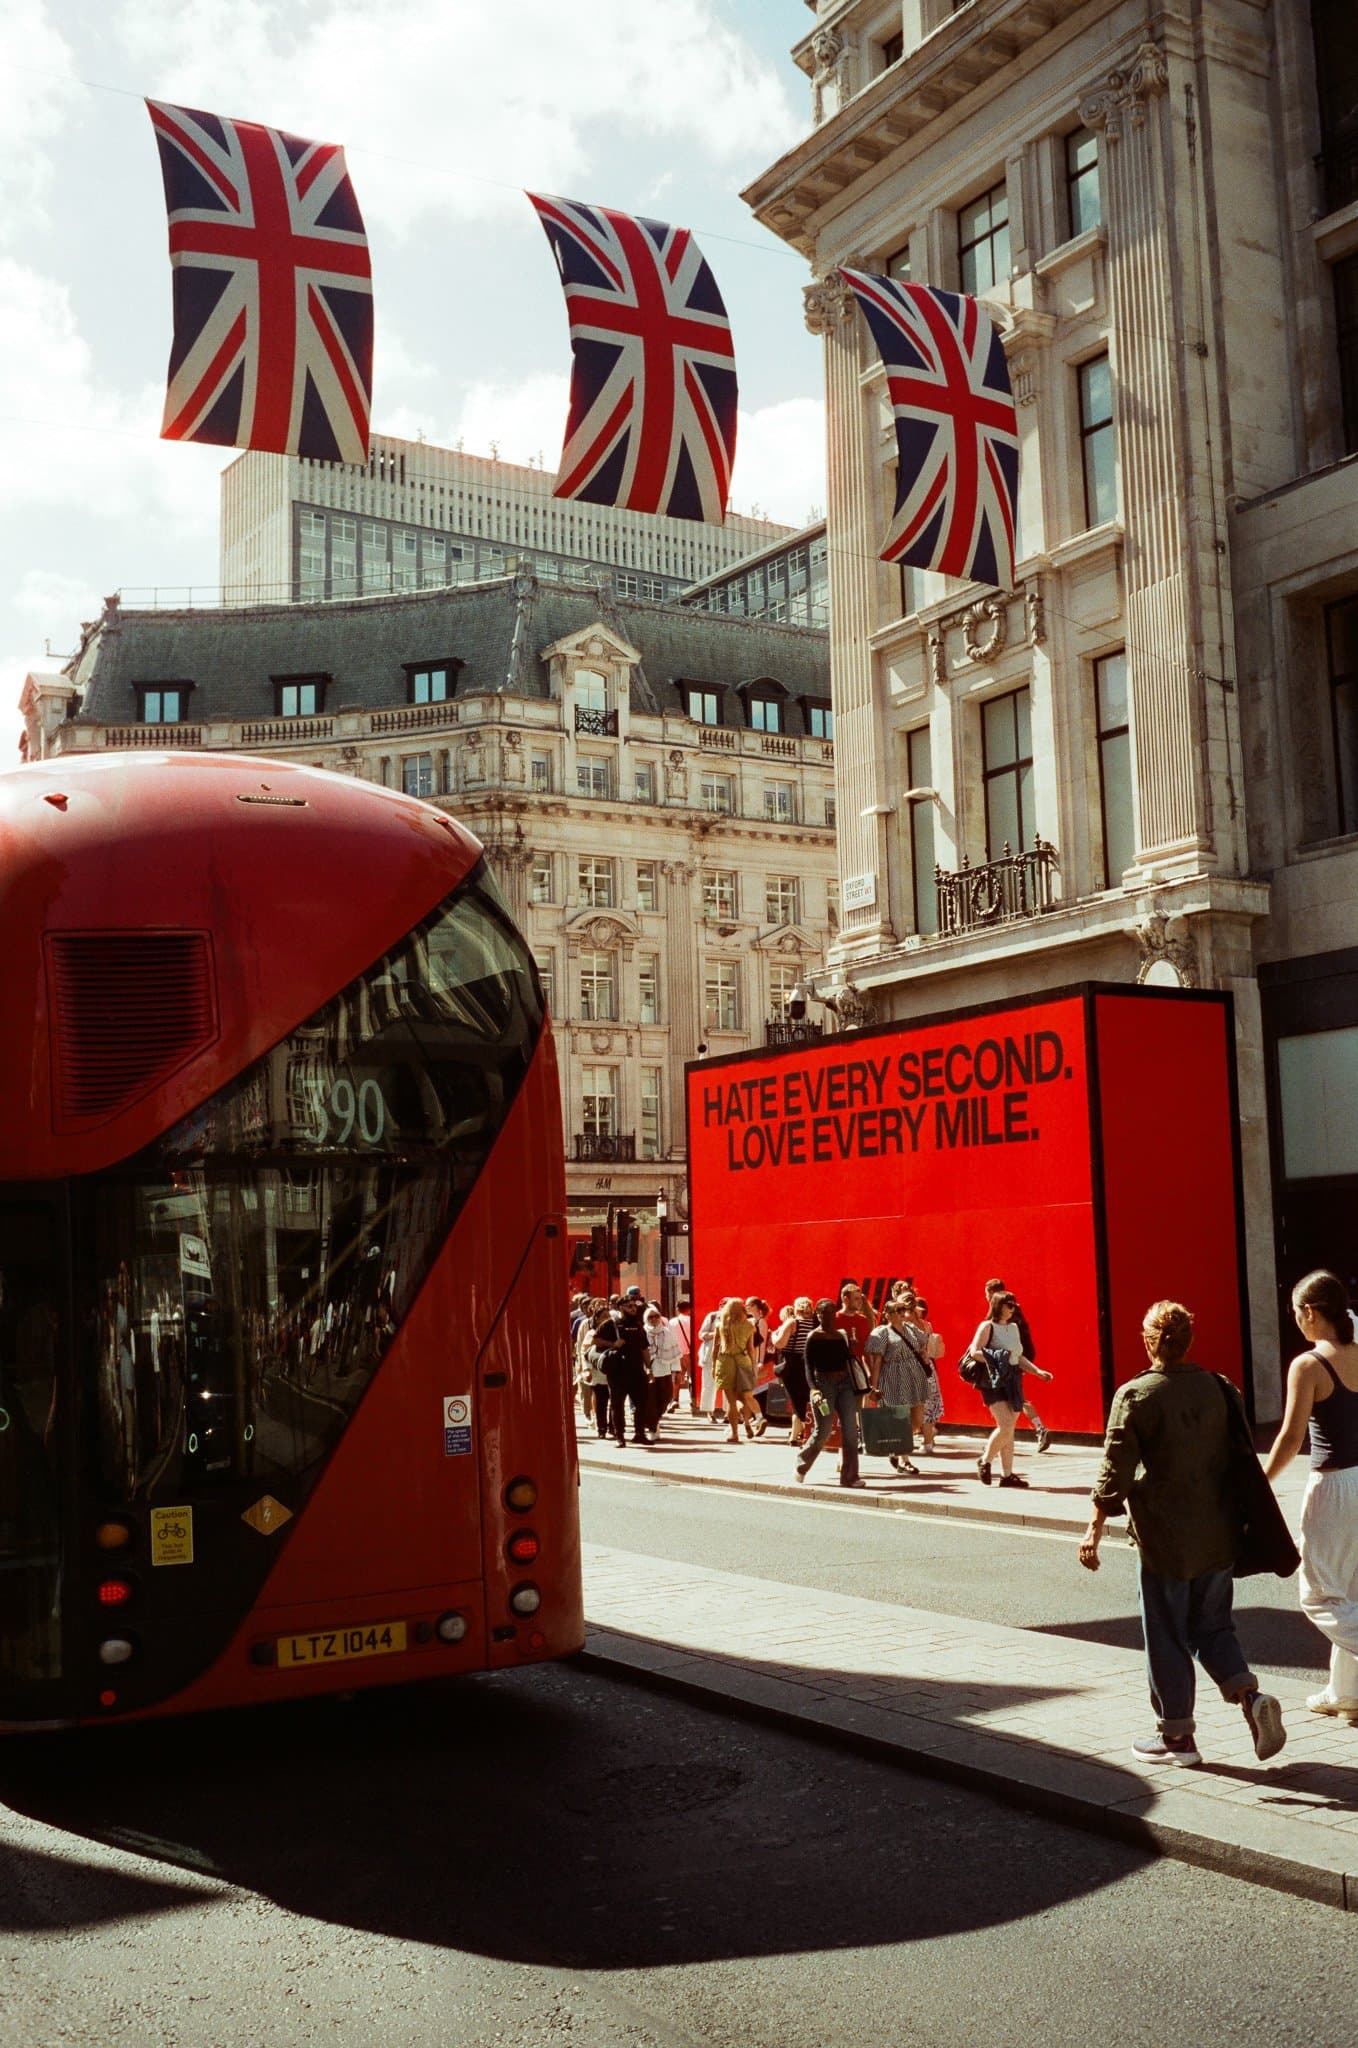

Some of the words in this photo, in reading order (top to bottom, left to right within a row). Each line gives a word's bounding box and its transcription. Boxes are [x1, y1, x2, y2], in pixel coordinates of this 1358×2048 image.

[846, 888, 864, 901] STREET
[704, 1077, 778, 1127] HATE
[784, 1057, 891, 1116] EVERY
[899, 1031, 1073, 1101] SECOND.
[303, 1079, 385, 1144] 390
[728, 1120, 806, 1171] LOVE
[813, 1104, 927, 1162] EVERY
[936, 1092, 1039, 1150] MILE.
[155, 1511, 188, 1520] Caution
[292, 1634, 337, 1661] LTZ
[343, 1626, 393, 1655] 1044
